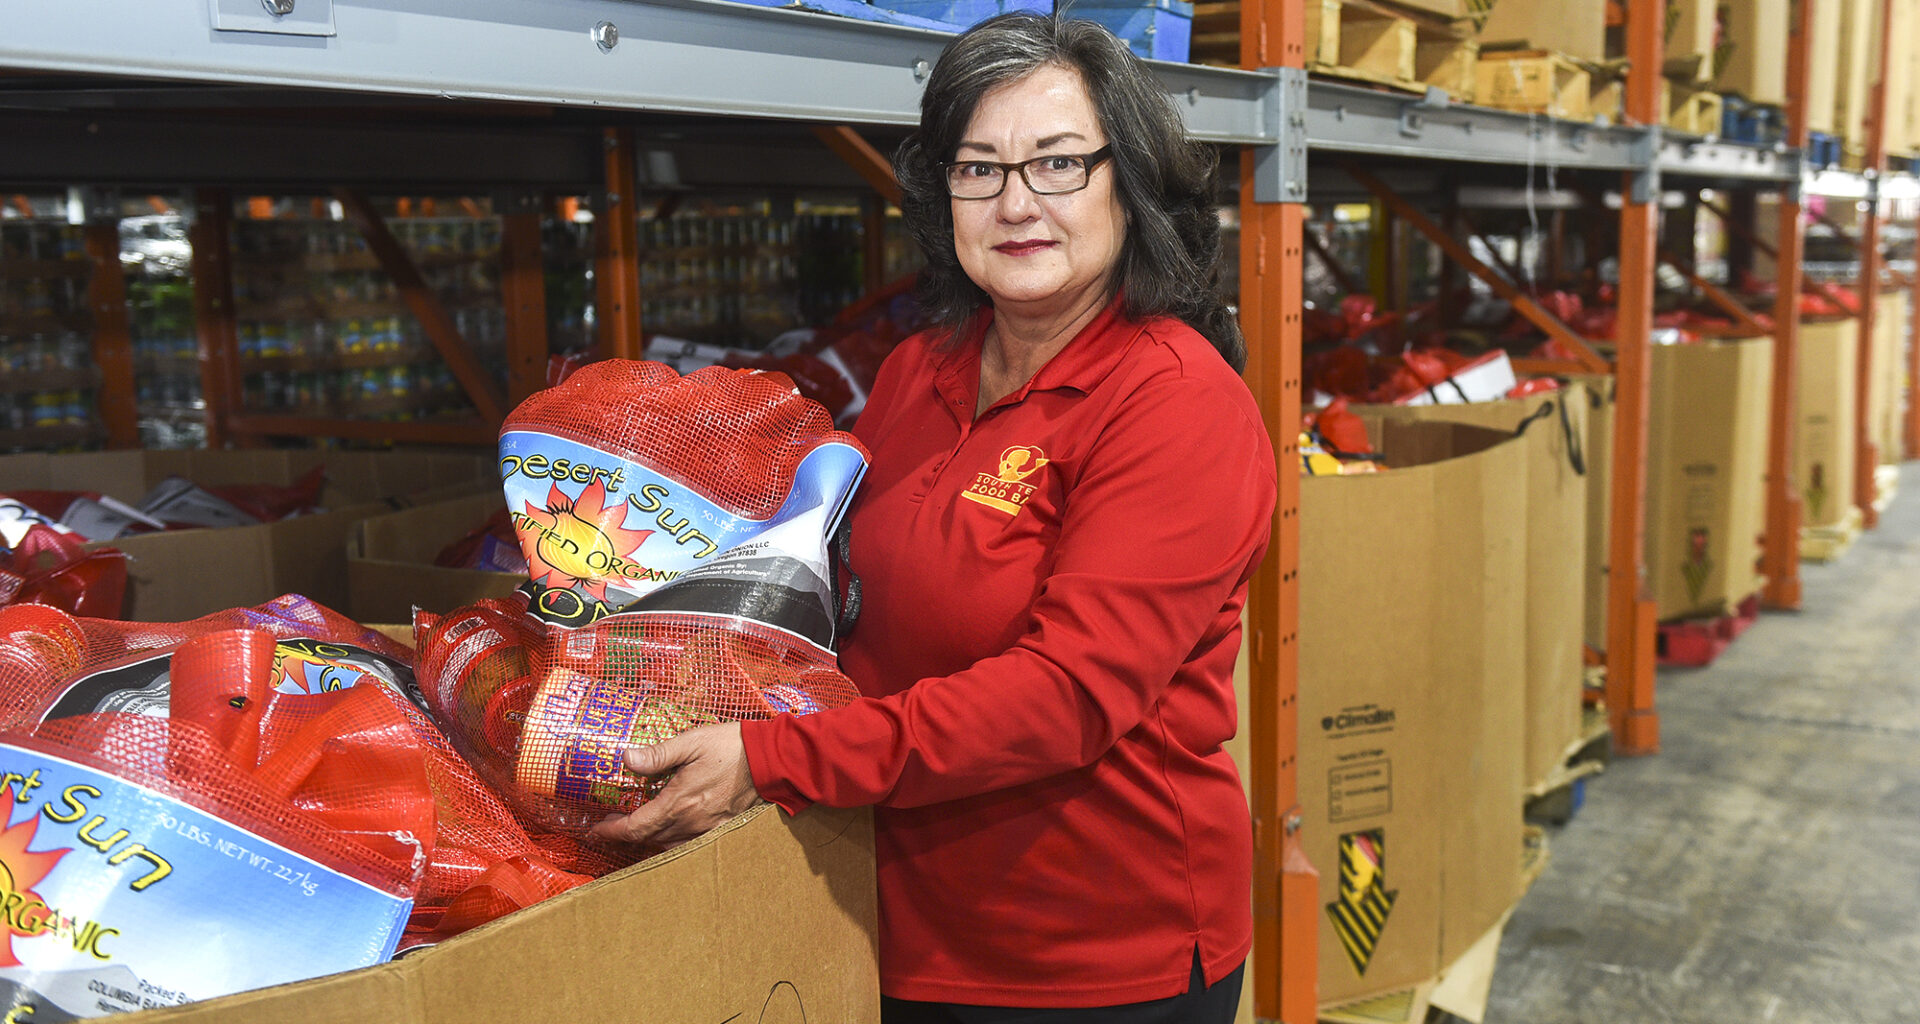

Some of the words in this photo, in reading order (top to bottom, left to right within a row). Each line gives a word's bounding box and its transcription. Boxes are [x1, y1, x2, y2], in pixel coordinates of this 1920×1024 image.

[500, 454, 626, 492] Desert
[628, 483, 719, 559] Sun
[970, 483, 1007, 498] FOOD
[977, 475, 1012, 490] SOUTH
[1018, 484, 1033, 496] TE
[510, 511, 580, 555] TIFIED
[42, 784, 173, 892] Sun
[214, 838, 250, 860] NET
[300, 872, 320, 896] kg
[0, 889, 120, 960] RGANIC
